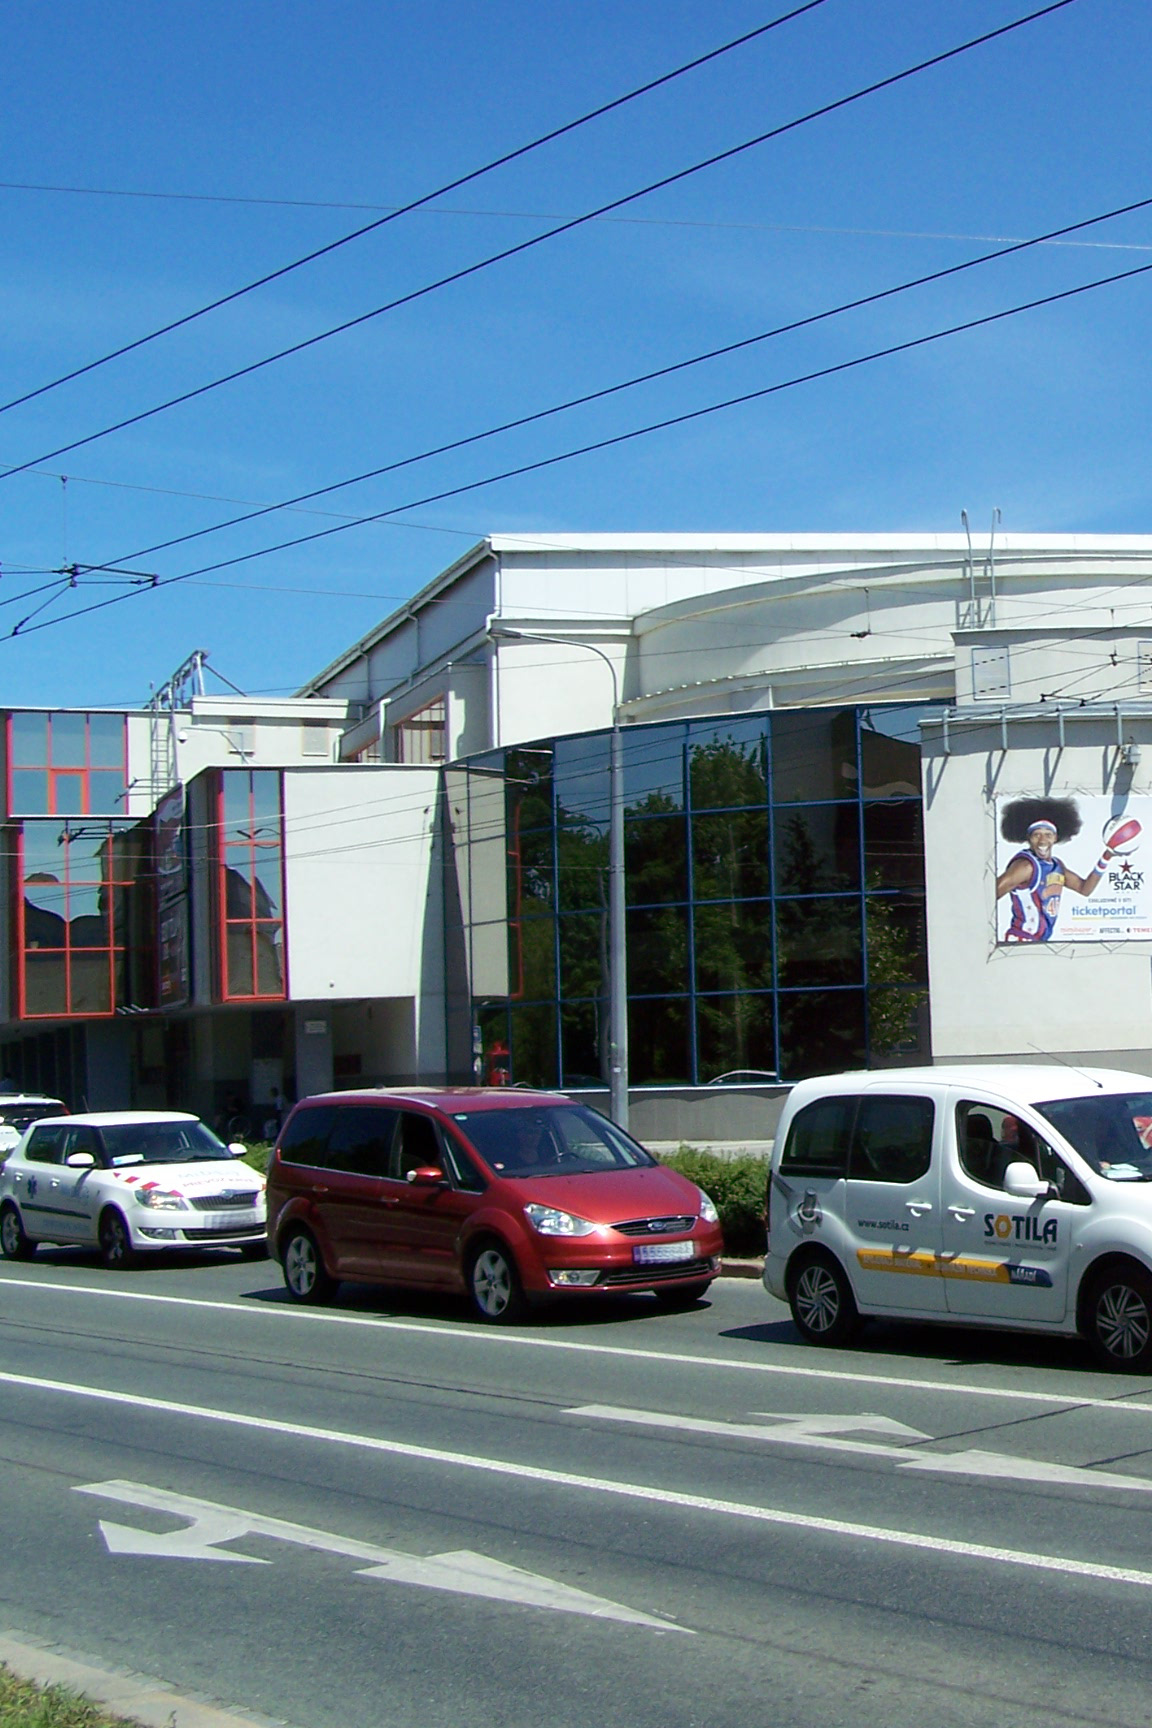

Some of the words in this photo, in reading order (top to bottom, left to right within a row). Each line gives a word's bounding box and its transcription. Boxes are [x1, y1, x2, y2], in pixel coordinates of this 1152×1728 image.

[1109, 872, 1145, 884] BLACK
[1113, 882, 1141, 891] STAR
[1072, 906, 1136, 917] ticketportal
[857, 1218, 910, 1232] www.sotila.cz
[983, 1213, 1058, 1245] SOTILA
